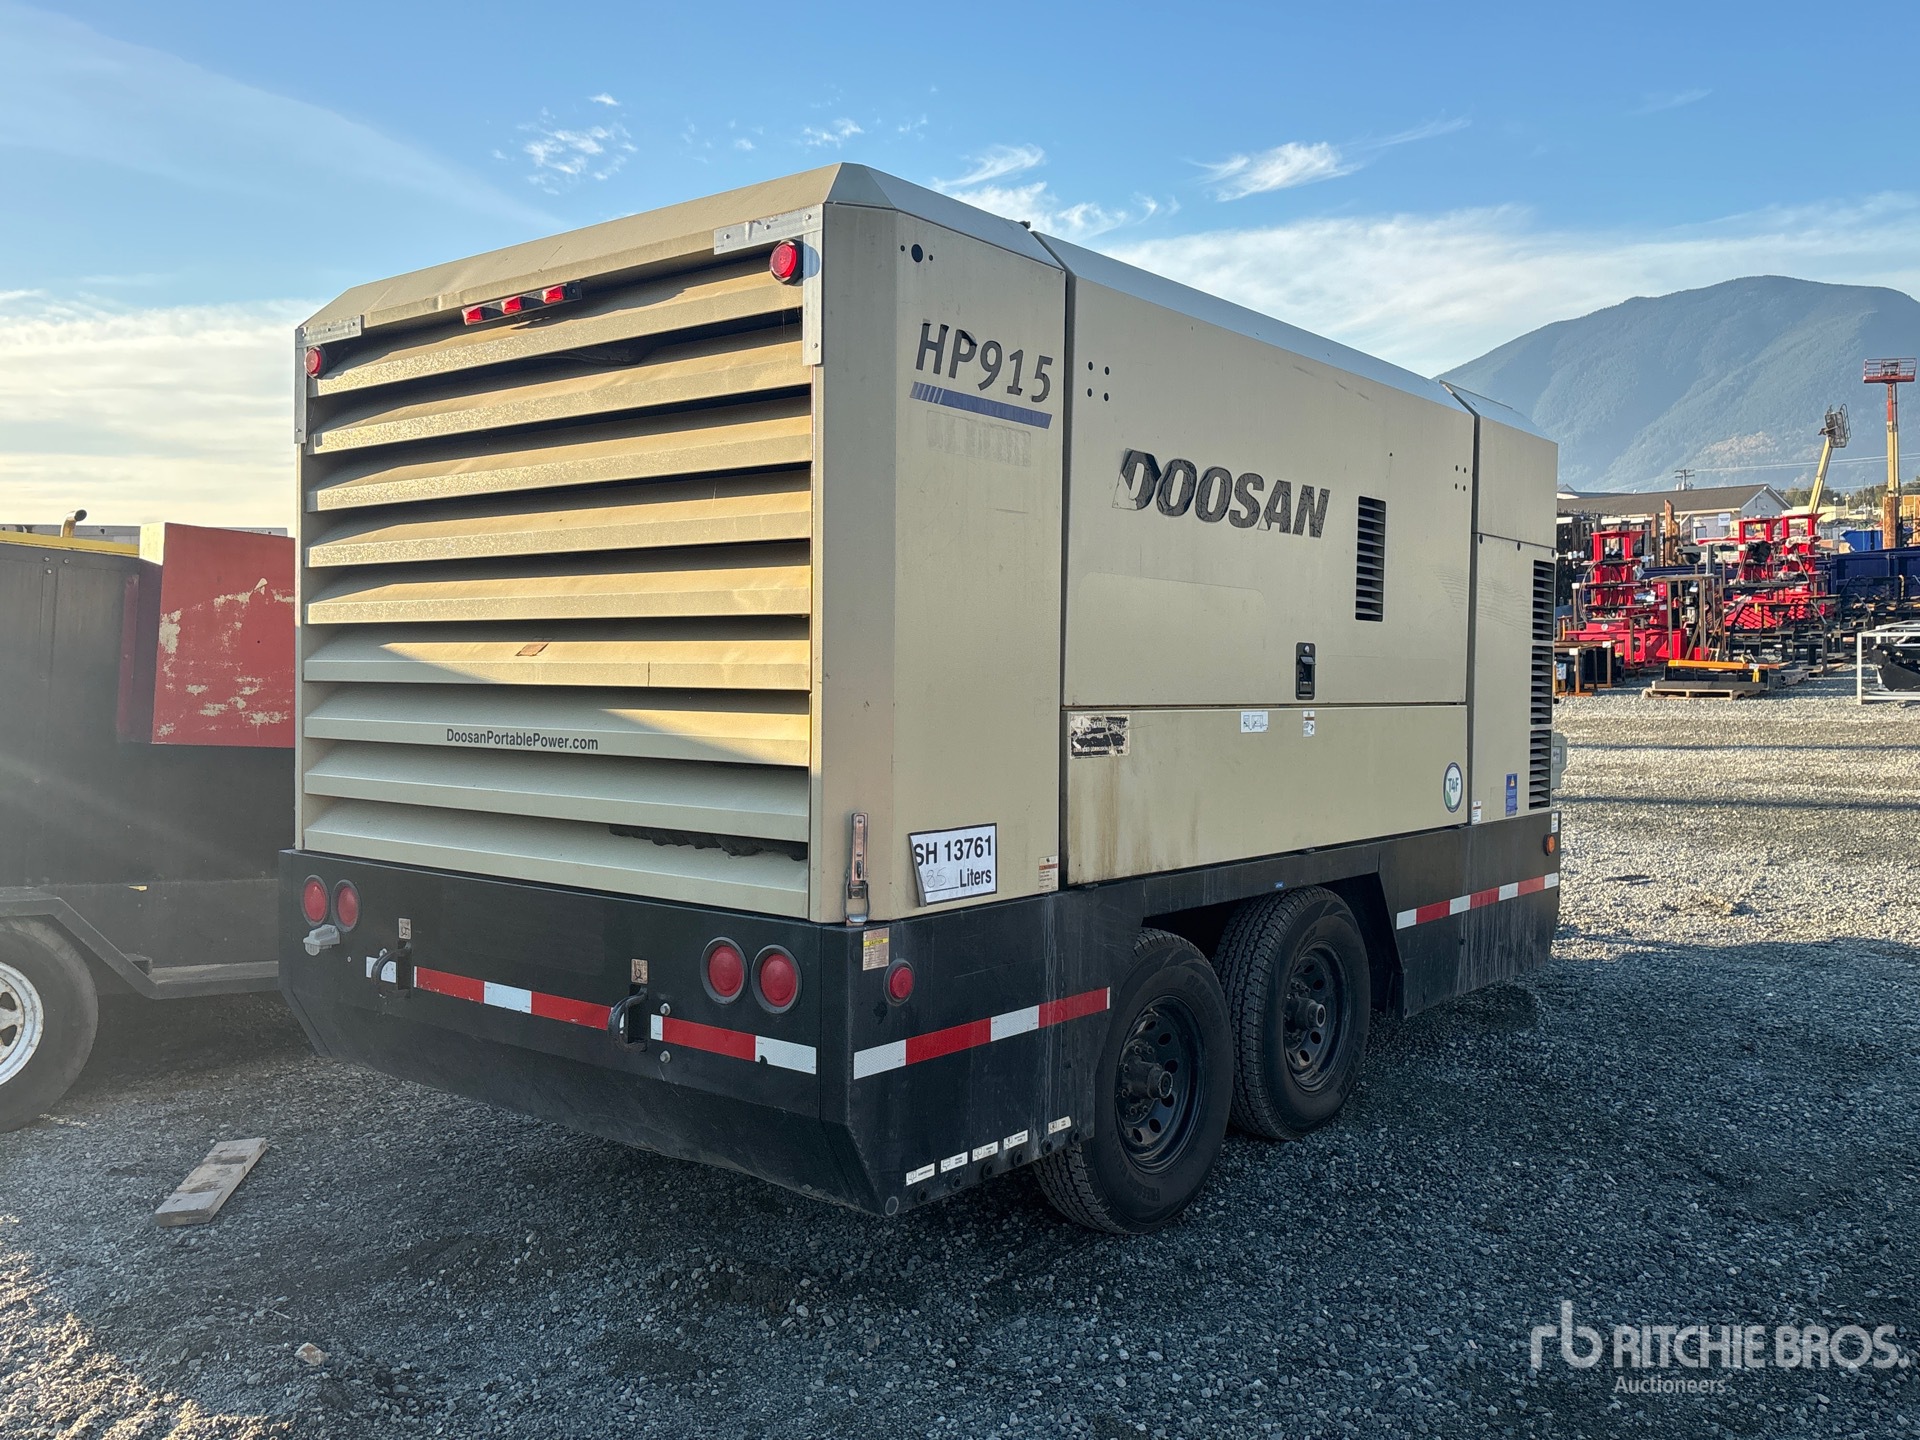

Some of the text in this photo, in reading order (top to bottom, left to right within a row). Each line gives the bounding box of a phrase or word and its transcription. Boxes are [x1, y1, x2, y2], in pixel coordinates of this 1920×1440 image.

[915, 320, 1053, 403] HP915
[1112, 448, 1331, 539] DOOSAN
[446, 728, 599, 750] DoosanPortablePower.com
[944, 834, 992, 862] 13761
[959, 867, 992, 888] Liters
